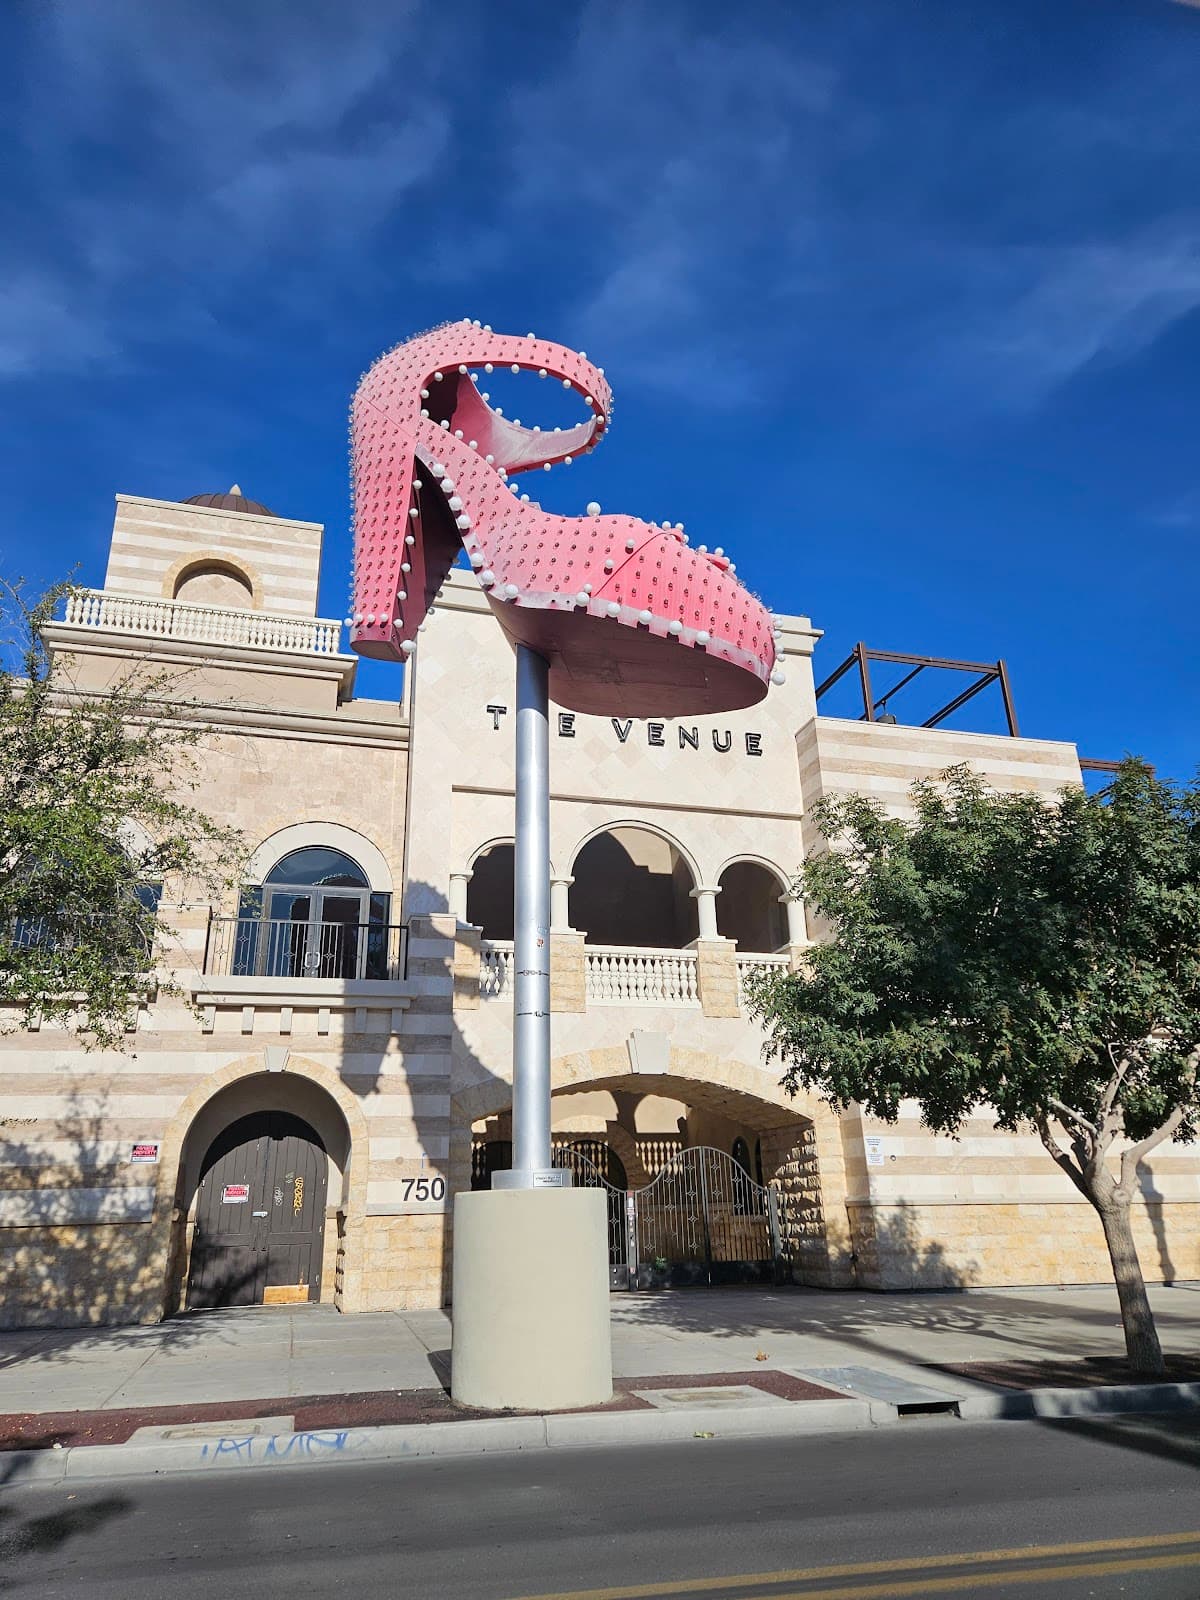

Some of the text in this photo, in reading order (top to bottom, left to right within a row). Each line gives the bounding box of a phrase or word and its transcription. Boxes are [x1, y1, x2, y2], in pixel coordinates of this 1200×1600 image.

[487, 705, 763, 756] TE VENUE
[401, 1177, 445, 1201] 750
